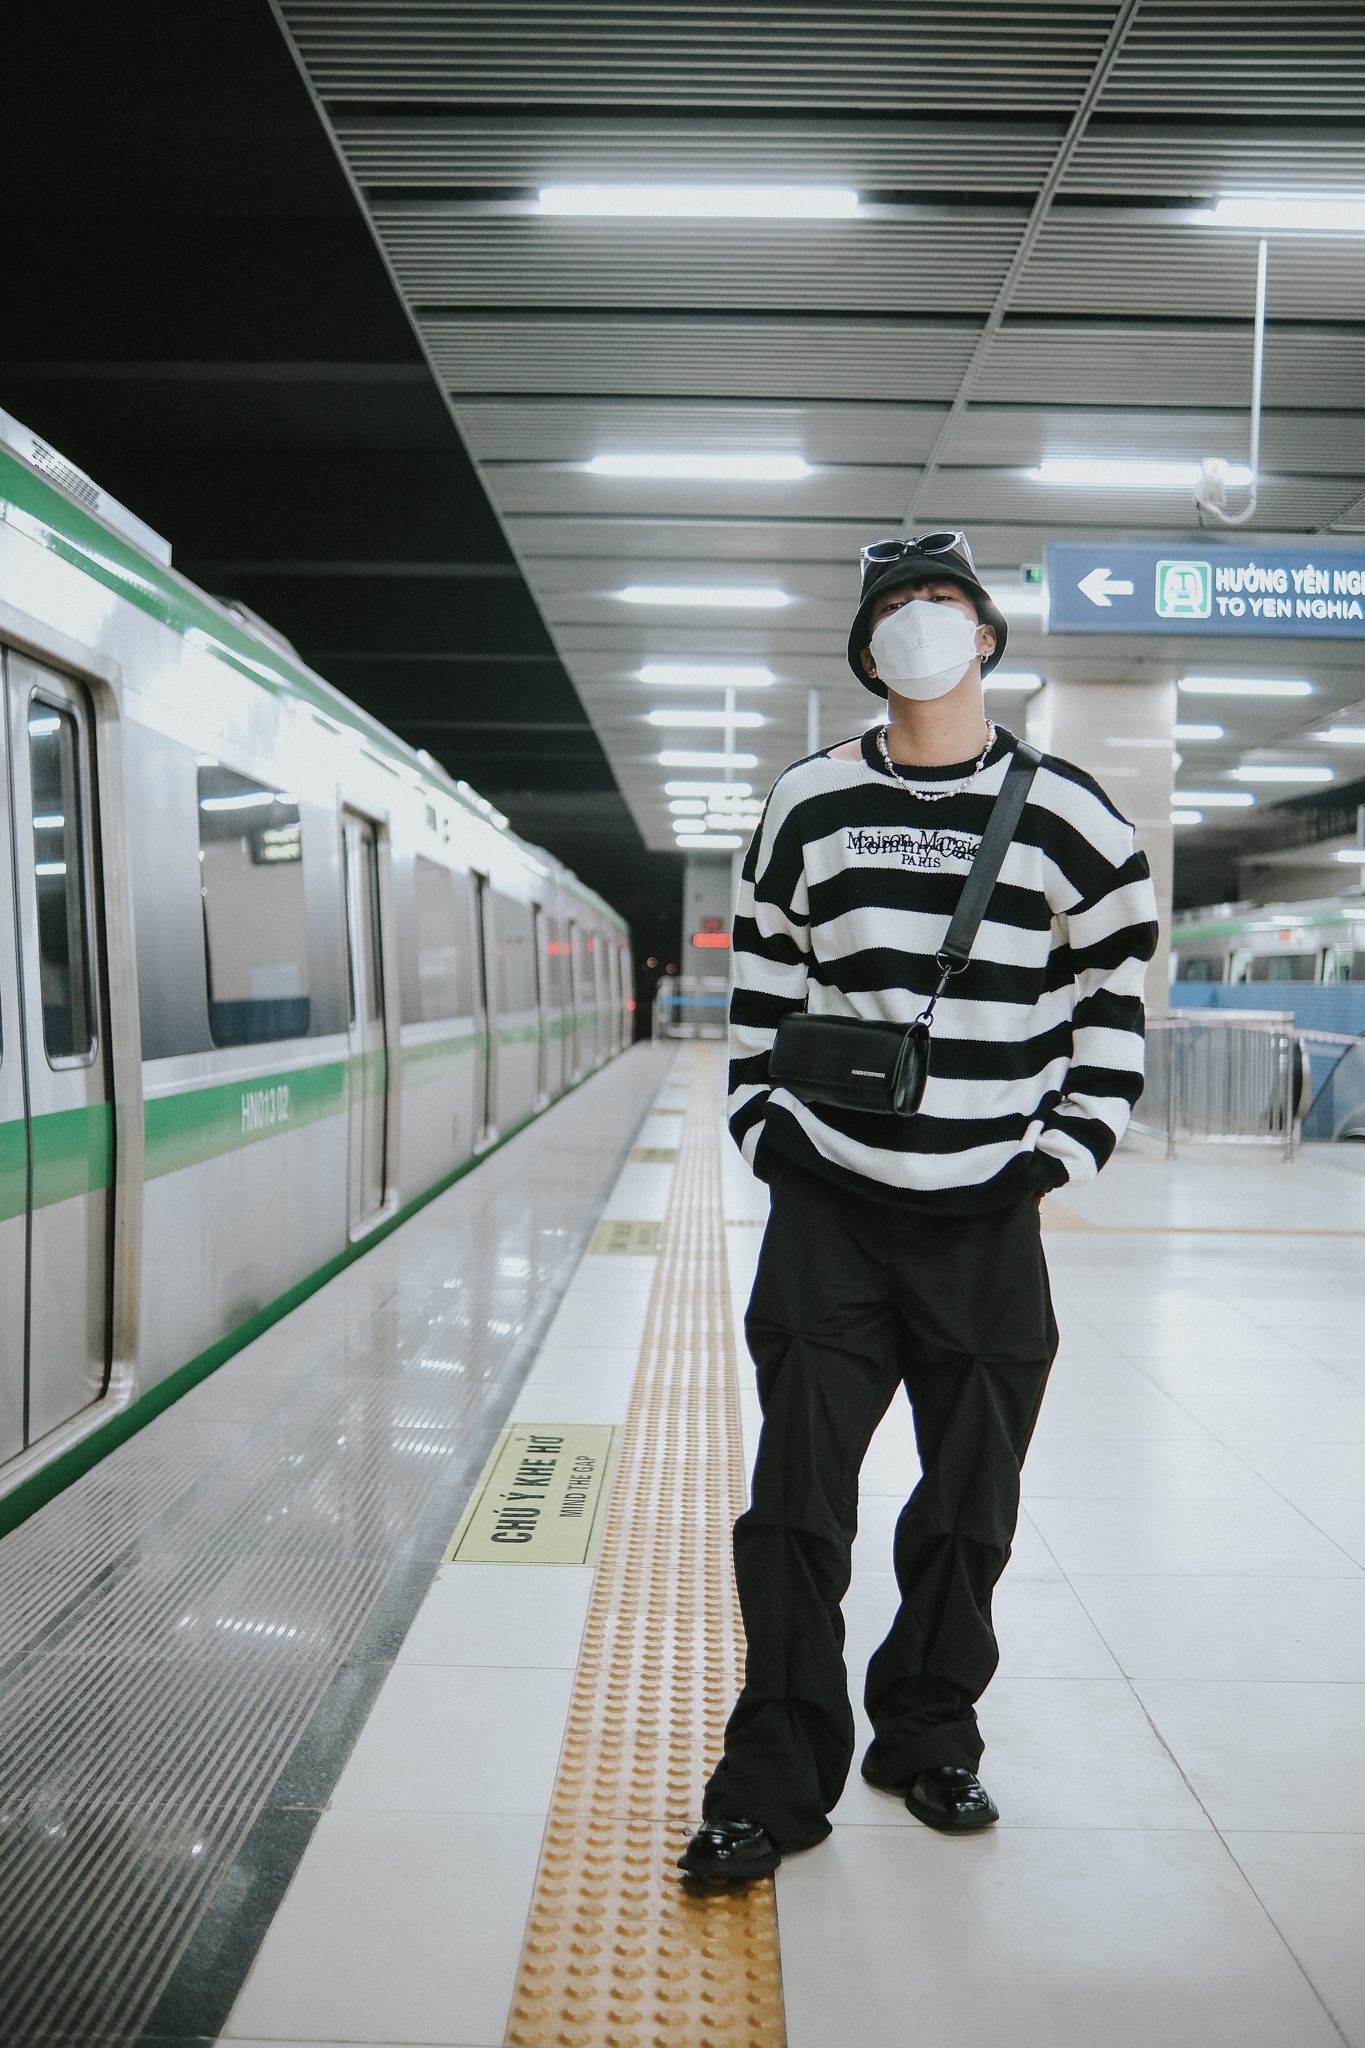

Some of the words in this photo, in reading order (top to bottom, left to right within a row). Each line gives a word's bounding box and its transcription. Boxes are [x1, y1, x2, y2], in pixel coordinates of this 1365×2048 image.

[1290, 563, 1330, 595] YÊN
[1215, 597, 1246, 617] TO
[1248, 597, 1292, 618] YEN
[1295, 598, 1363, 620] NGHIA
[846, 830, 912, 849] Maison
[901, 853, 941, 868] PARIS
[512, 1458, 558, 1487] KHE
[572, 1455, 596, 1473] GAP
[567, 1474, 592, 1490] THE
[499, 1491, 546, 1501] Ý
[559, 1492, 587, 1518] MIND
[490, 1507, 542, 1544] CHÚ
